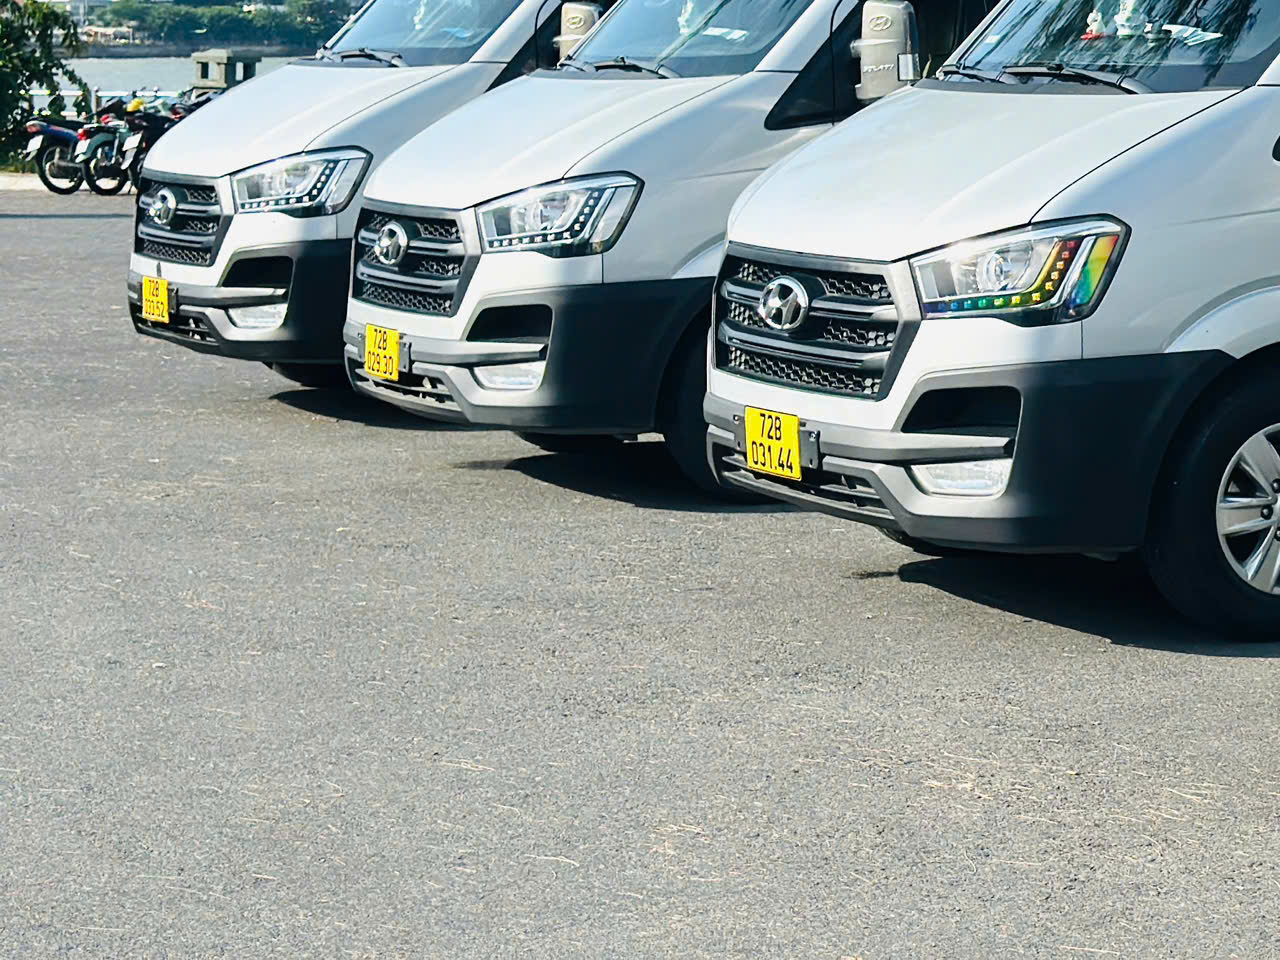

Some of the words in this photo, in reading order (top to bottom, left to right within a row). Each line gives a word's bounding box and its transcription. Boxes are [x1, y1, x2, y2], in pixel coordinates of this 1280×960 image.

[374, 328, 388, 351] 72B
[760, 412, 782, 441] 72B
[751, 440, 794, 474] 031.44
